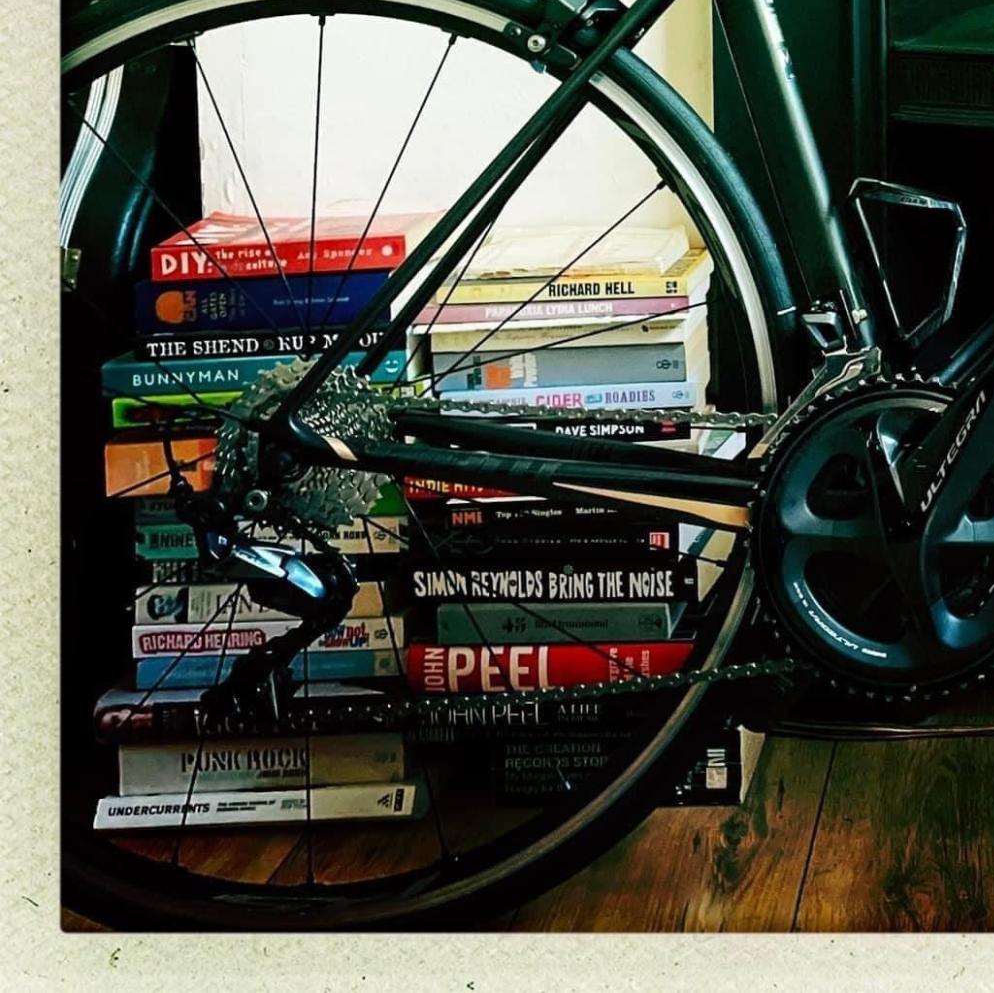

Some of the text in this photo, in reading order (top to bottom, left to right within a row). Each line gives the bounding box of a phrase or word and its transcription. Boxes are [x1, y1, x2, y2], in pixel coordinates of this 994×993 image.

[238, 247, 261, 259] rise
[161, 251, 213, 276] DIY:
[548, 281, 635, 297] RICHARD HELL
[578, 301, 613, 315] LUNCH
[147, 341, 187, 357] THE
[193, 337, 260, 356] SHEND
[132, 369, 240, 387] BUNNYMAN
[536, 393, 584, 408] CIDER
[605, 389, 656, 405] ROADIES
[555, 424, 588, 437] DAVE
[920, 390, 987, 512] ULTEGRA
[413, 570, 468, 597] SIMON
[470, 570, 543, 598] REYNOLDS
[597, 571, 625, 598] THE
[423, 647, 446, 692] JOHN
[448, 645, 557, 694] PEEL
